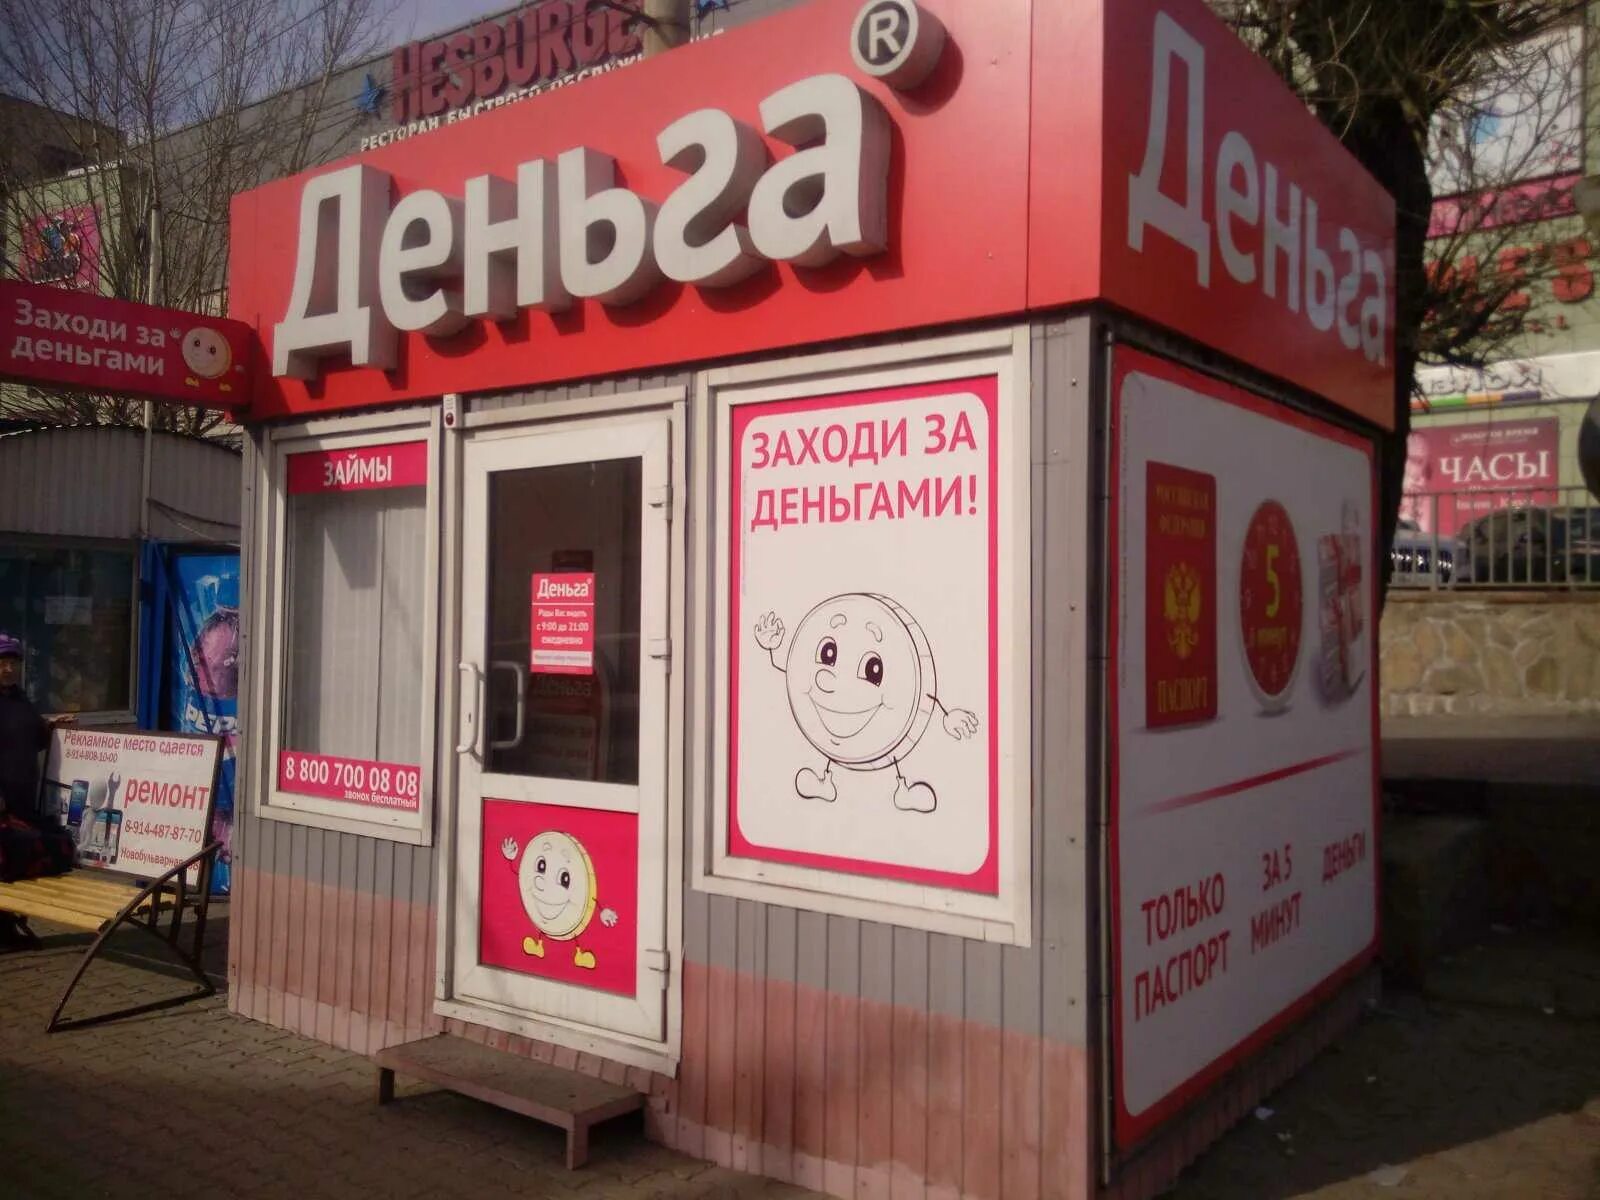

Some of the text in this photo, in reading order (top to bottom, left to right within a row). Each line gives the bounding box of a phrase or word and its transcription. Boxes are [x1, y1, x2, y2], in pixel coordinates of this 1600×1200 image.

[390, 0, 646, 124] HESBURGE
[360, 116, 440, 152] РЕСТОРАН
[1127, 10, 1386, 368] Деньга
[273, 73, 864, 378] Деньга
[15, 299, 165, 348] Заходи за
[11, 335, 165, 376] деньгами
[751, 410, 978, 469] ЗАХОДИ ЗА
[323, 453, 392, 486] ЗАЙМЫ
[1439, 451, 1551, 484] ЧАСЫ
[750, 474, 978, 533] ДЕНЬГАМИ!
[536, 578, 589, 600] Деньга
[1266, 544, 1280, 618] 5
[568, 622, 589, 632] 21:00
[64, 729, 204, 757] Рекламное место сдается
[124, 778, 210, 811] ремонт
[285, 756, 418, 797] 8 800 700 08 08
[344, 790, 417, 809] звонок бесплатный
[125, 819, 202, 844] 8-914-487-87-70
[1262, 843, 1292, 892] ЗА 5
[1322, 830, 1366, 883] ДЕНЬГИ
[1141, 872, 1225, 946] ТОЛЬКО
[1251, 891, 1303, 955] МИНУТ
[1135, 930, 1231, 1022] ПАСПОРТ
